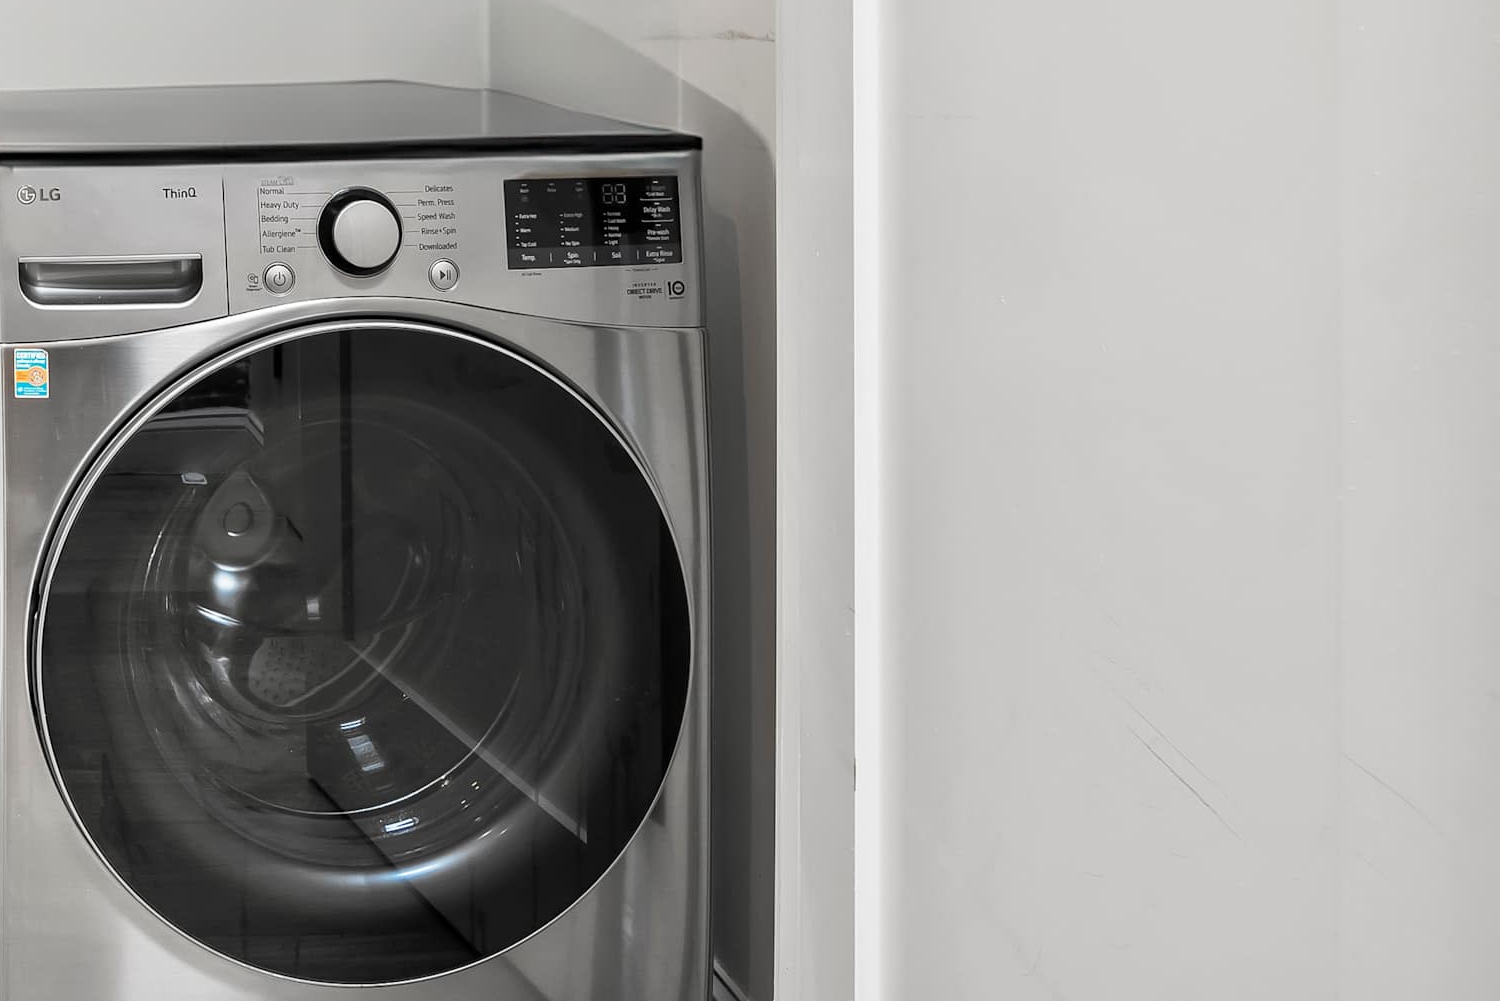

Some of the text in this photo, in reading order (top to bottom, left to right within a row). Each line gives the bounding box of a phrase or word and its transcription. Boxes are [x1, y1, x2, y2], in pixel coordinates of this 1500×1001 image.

[40, 188, 61, 201] LG
[163, 187, 197, 198] ThinQ
[260, 187, 284, 195] Normal
[261, 200, 299, 210] Heavy Duty
[261, 215, 289, 224] Bedding
[418, 212, 455, 221] Speed Wash
[262, 245, 295, 253] Tub Clean
[419, 242, 457, 250] Downloaded
